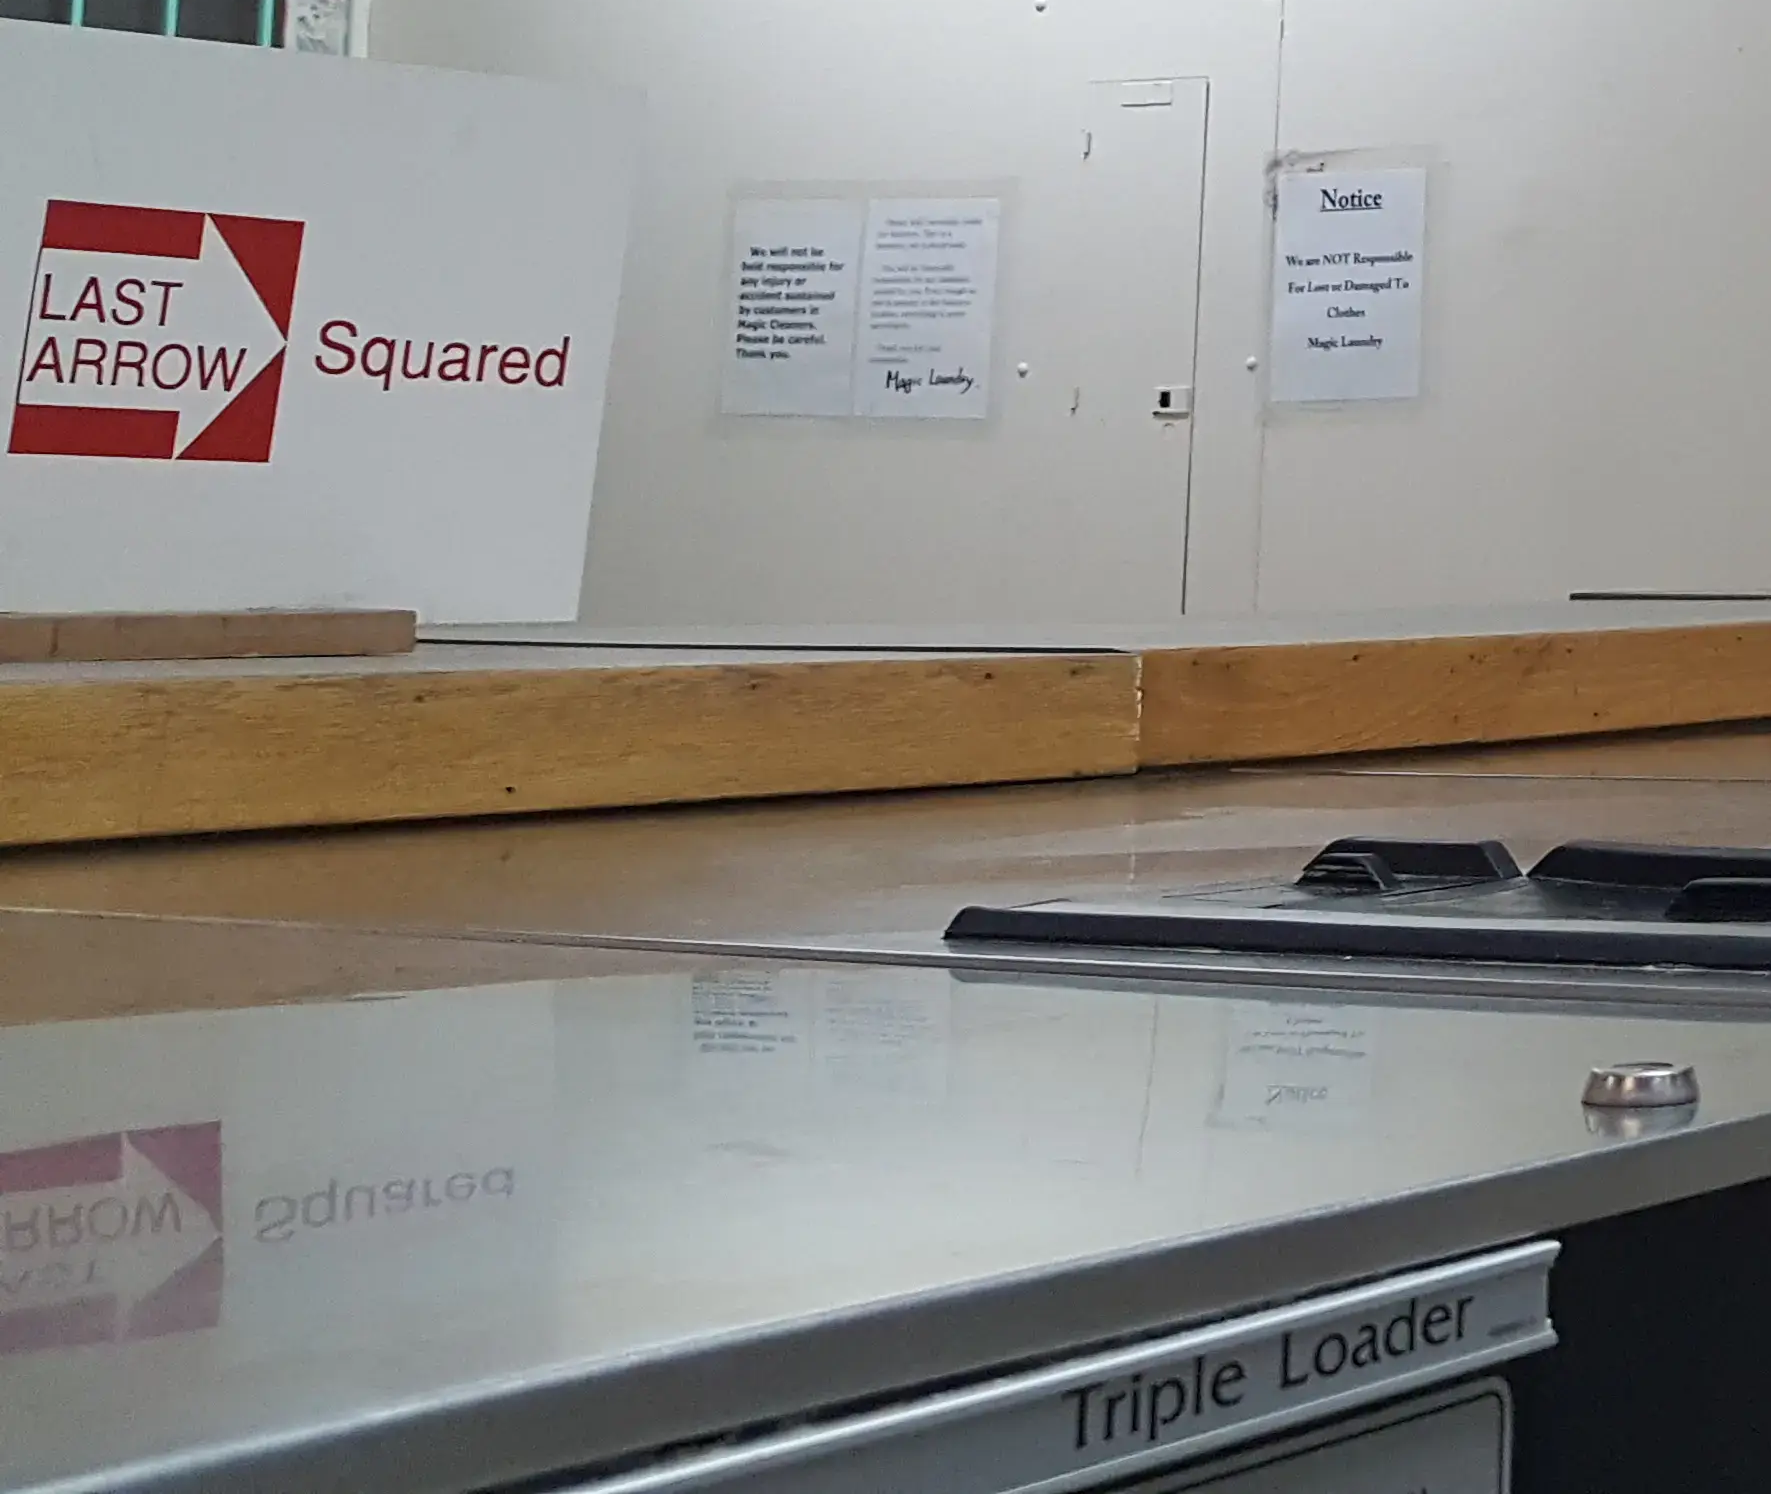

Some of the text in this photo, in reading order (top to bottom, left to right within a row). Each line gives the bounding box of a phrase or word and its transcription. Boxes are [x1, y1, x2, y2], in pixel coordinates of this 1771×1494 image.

[1320, 188, 1383, 211] Notice
[1286, 255, 1304, 266] We
[1323, 253, 1350, 266] NOT
[1353, 251, 1413, 267] Responsible
[761, 275, 792, 288] injury
[1288, 282, 1305, 294] For
[1344, 277, 1392, 293] Damaged
[1393, 277, 1409, 290] To
[38, 273, 183, 327] LAST
[739, 290, 836, 302] accident sustained
[753, 304, 807, 316] customers
[1326, 306, 1366, 318] Clothes
[738, 319, 766, 332] Magic
[736, 334, 770, 345] Please
[1307, 334, 1384, 350] Magic Laundry
[314, 319, 571, 392] Squared
[26, 336, 248, 392] ARROW
[885, 370, 923, 393] Magic
[1062, 1294, 1476, 1451] Triple Loader
